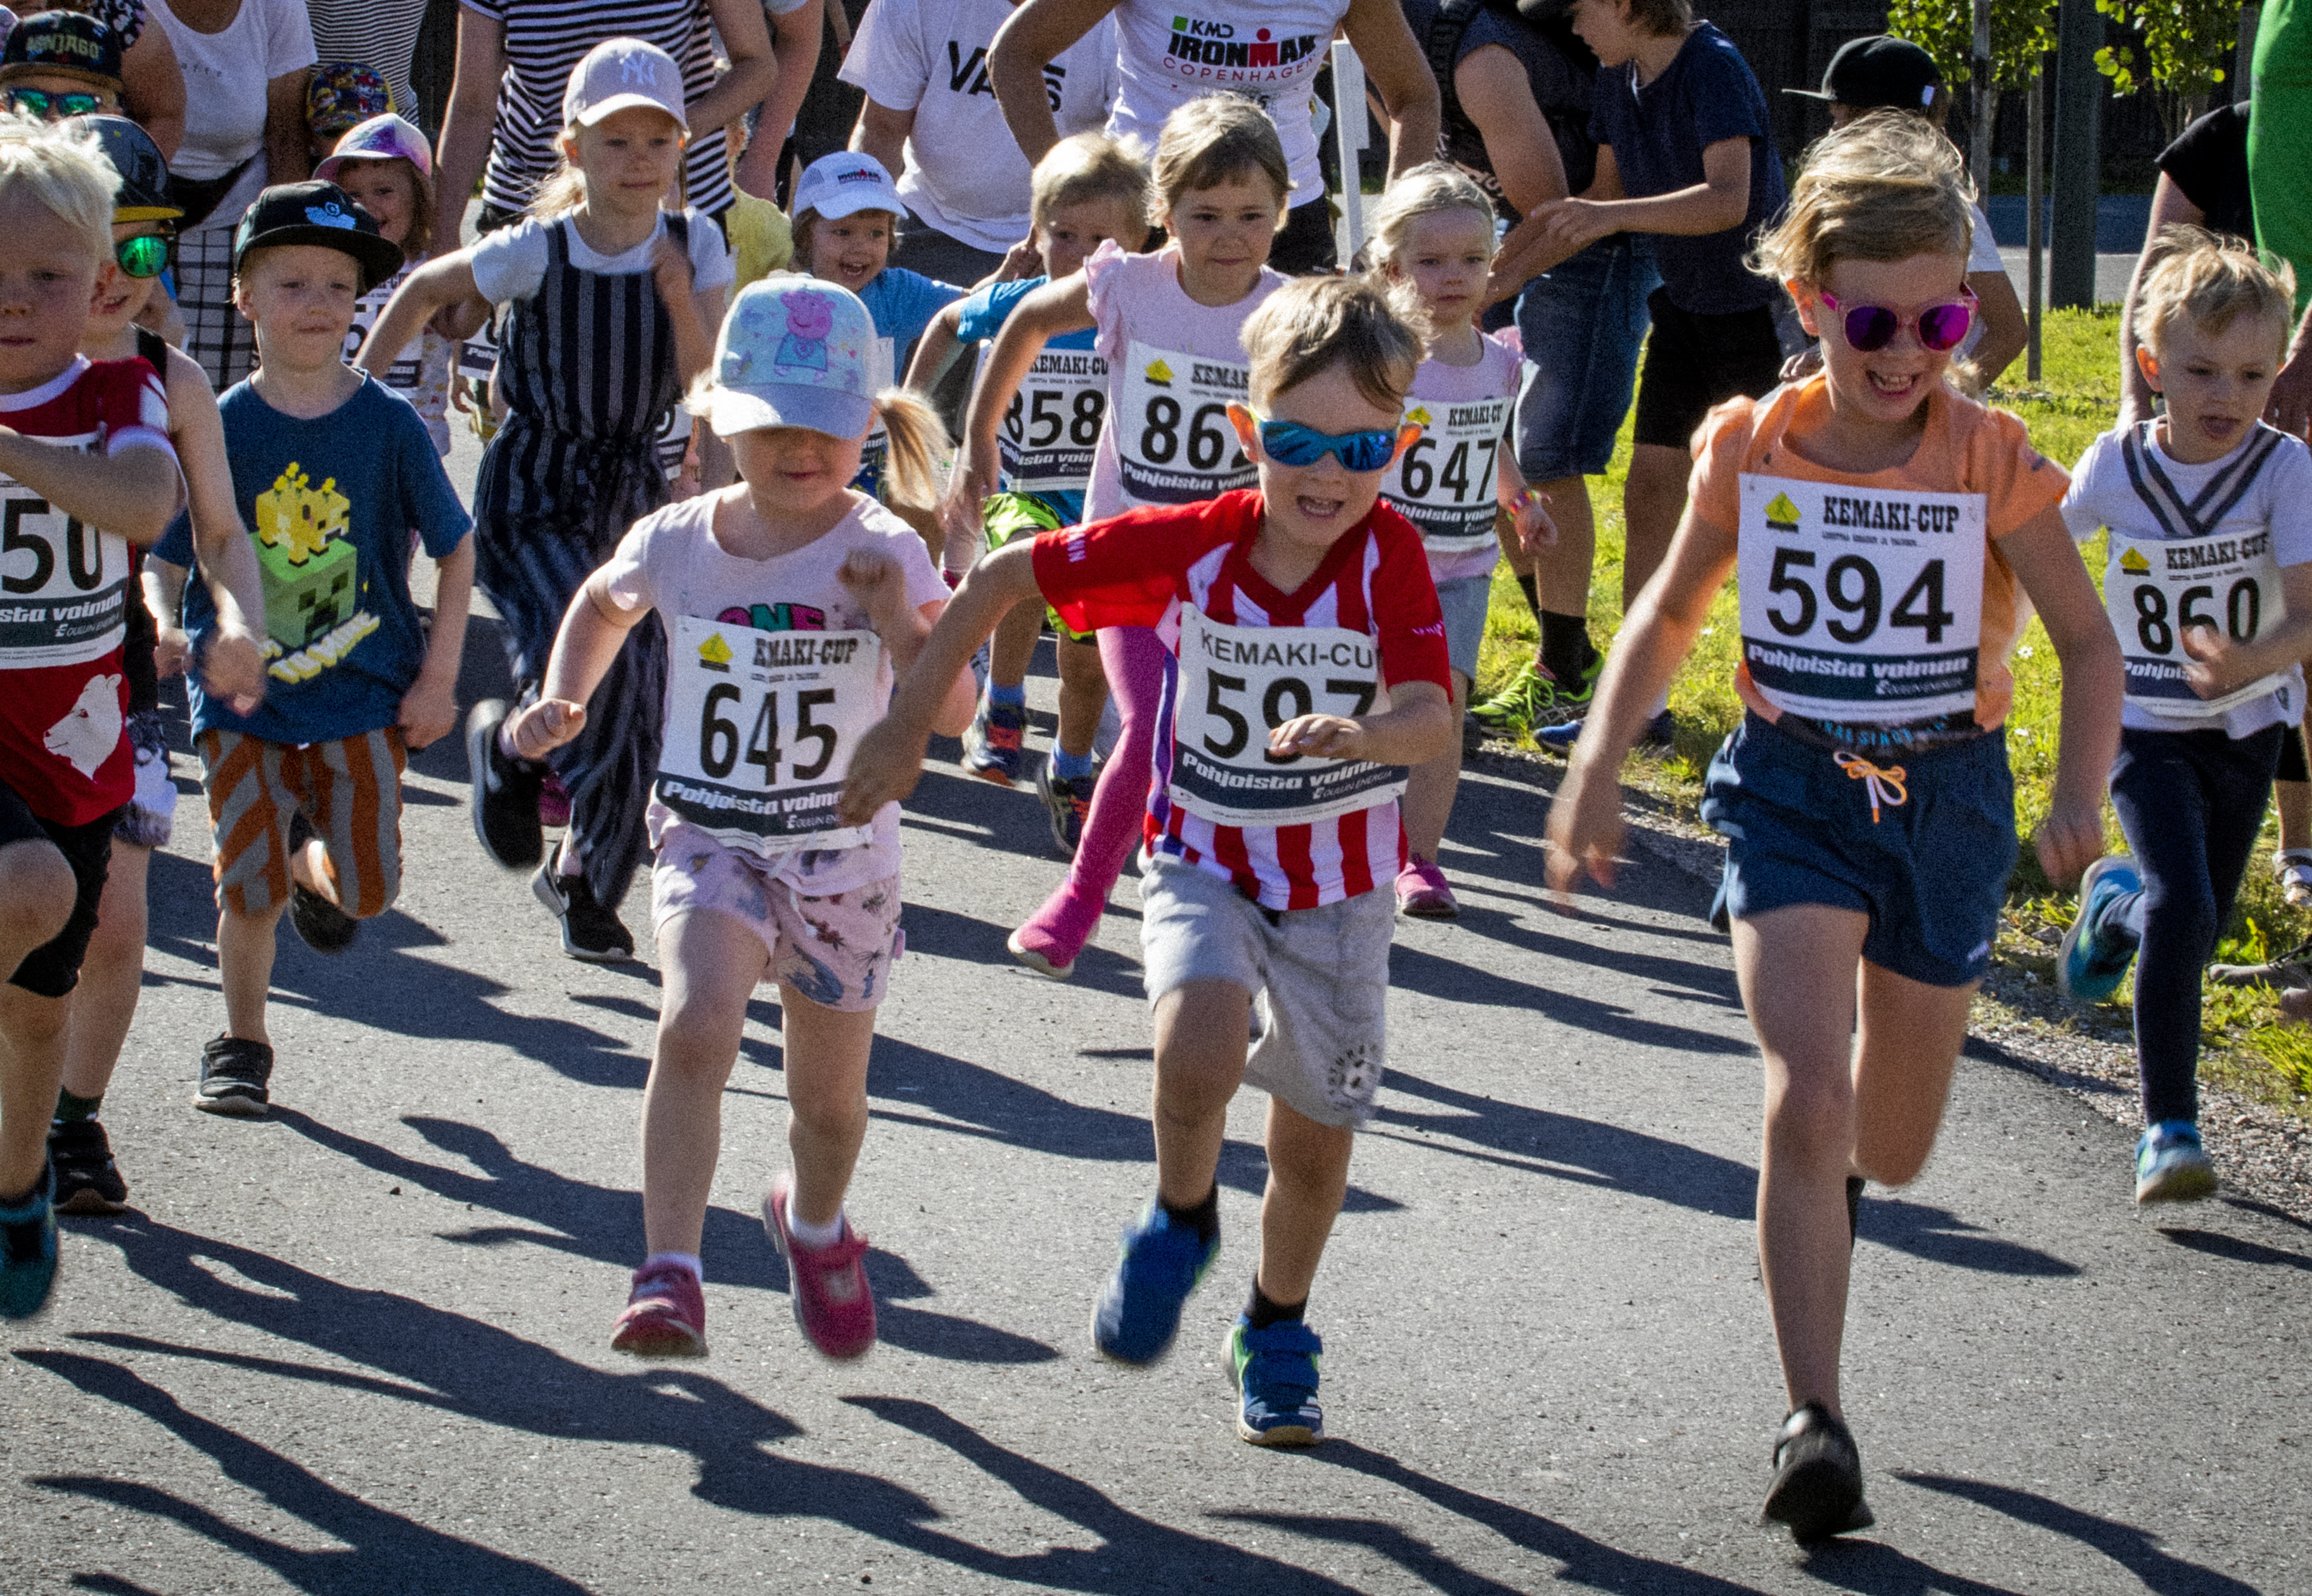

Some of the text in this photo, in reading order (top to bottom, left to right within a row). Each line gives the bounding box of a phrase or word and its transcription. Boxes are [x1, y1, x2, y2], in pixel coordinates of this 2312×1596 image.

[1168, 28, 1316, 68] IRONMAN
[1190, 20, 1234, 38] KMD
[948, 41, 1066, 113] VAS
[1029, 355, 1108, 375] KEMAKI-CU
[1141, 396, 1250, 470] 86
[1401, 437, 1497, 503] 647
[1823, 495, 1960, 533] KEMAKI-CUP
[1766, 546, 1954, 644] 594
[2133, 577, 2261, 659] 860
[1202, 627, 1374, 669] KEMAKI-CU
[1747, 643, 1969, 679] Pohjoista voimaa
[700, 682, 838, 786] 645
[1204, 667, 1377, 765] 597
[1183, 752, 1302, 789] Pohjoista
[664, 780, 778, 814] Pohjoista
